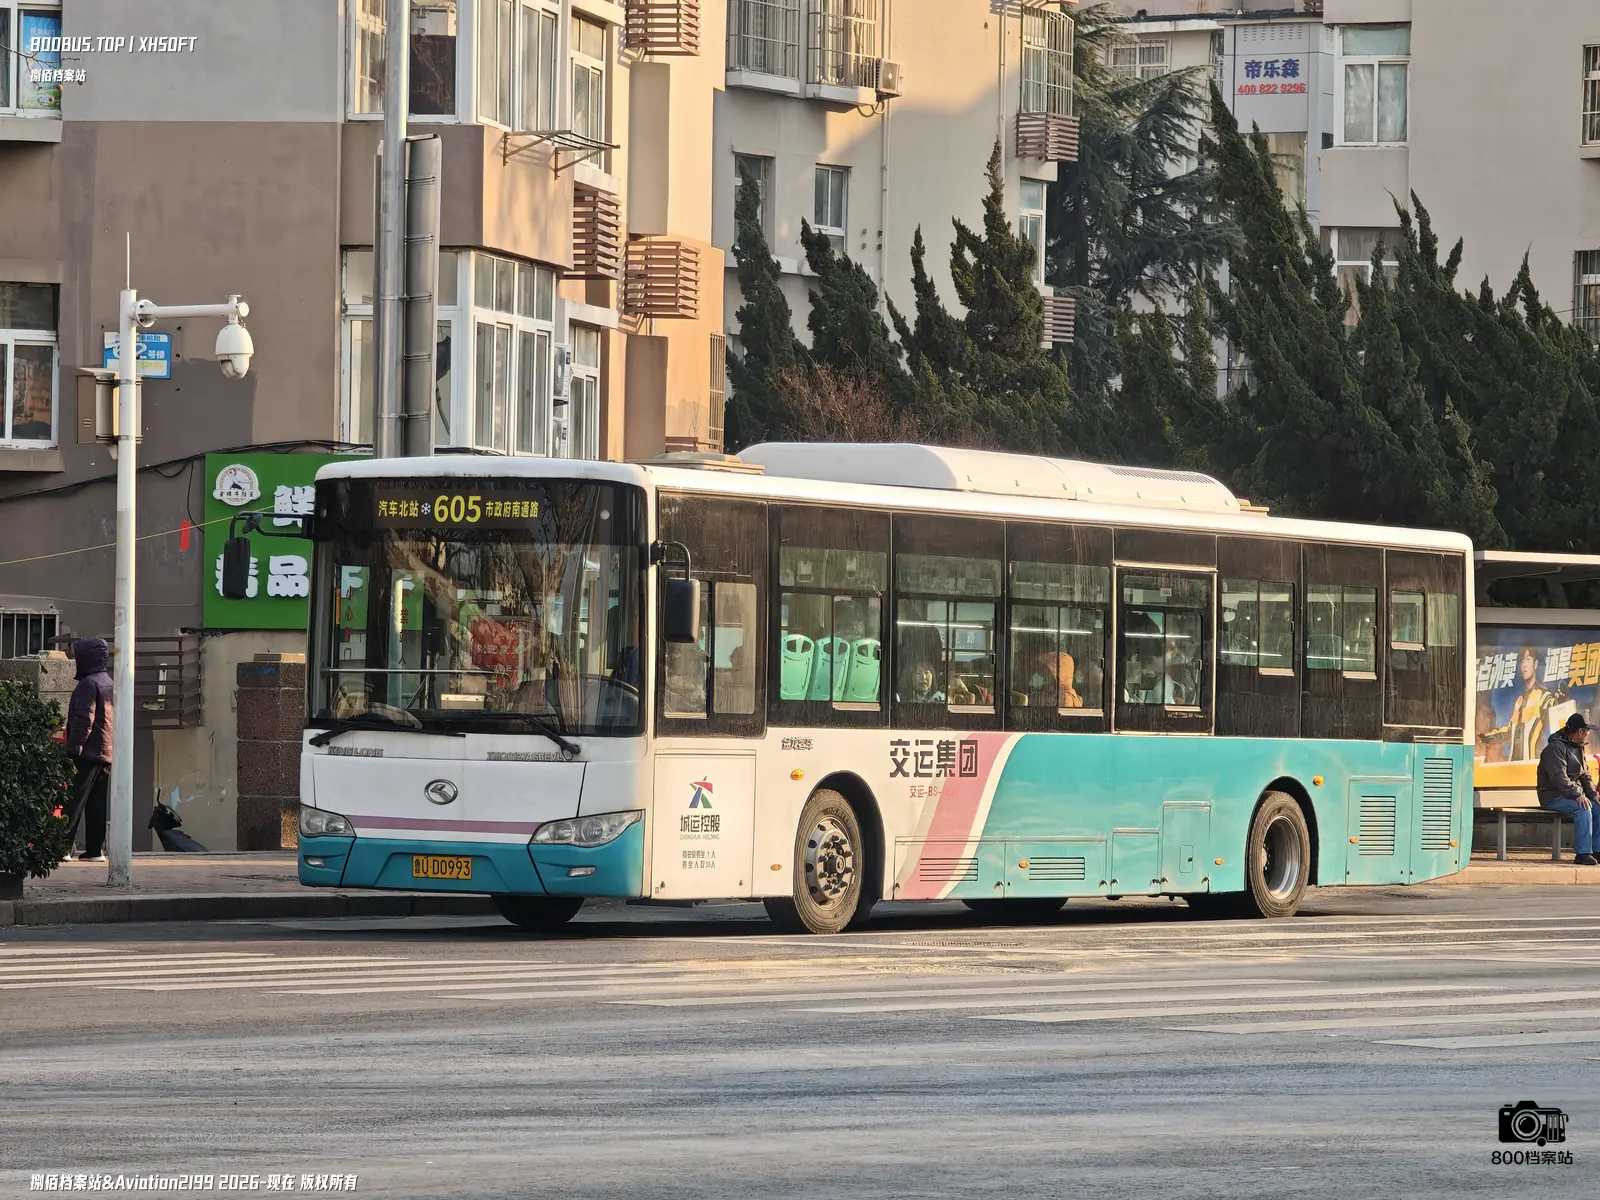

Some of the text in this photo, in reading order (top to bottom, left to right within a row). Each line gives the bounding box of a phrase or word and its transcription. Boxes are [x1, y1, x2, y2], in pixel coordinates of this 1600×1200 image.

[1244, 58, 1300, 79] 帝乐森
[1238, 84, 1256, 94] 400
[1259, 84, 1278, 94] 822
[378, 495, 539, 523] 汽车北站 605 市政府南通路
[1476, 642, 1600, 692] 点外卖 还是美团
[328, 746, 385, 758] KING LONG
[890, 739, 978, 778] 交运集团
[680, 814, 720, 832] 城运控股
